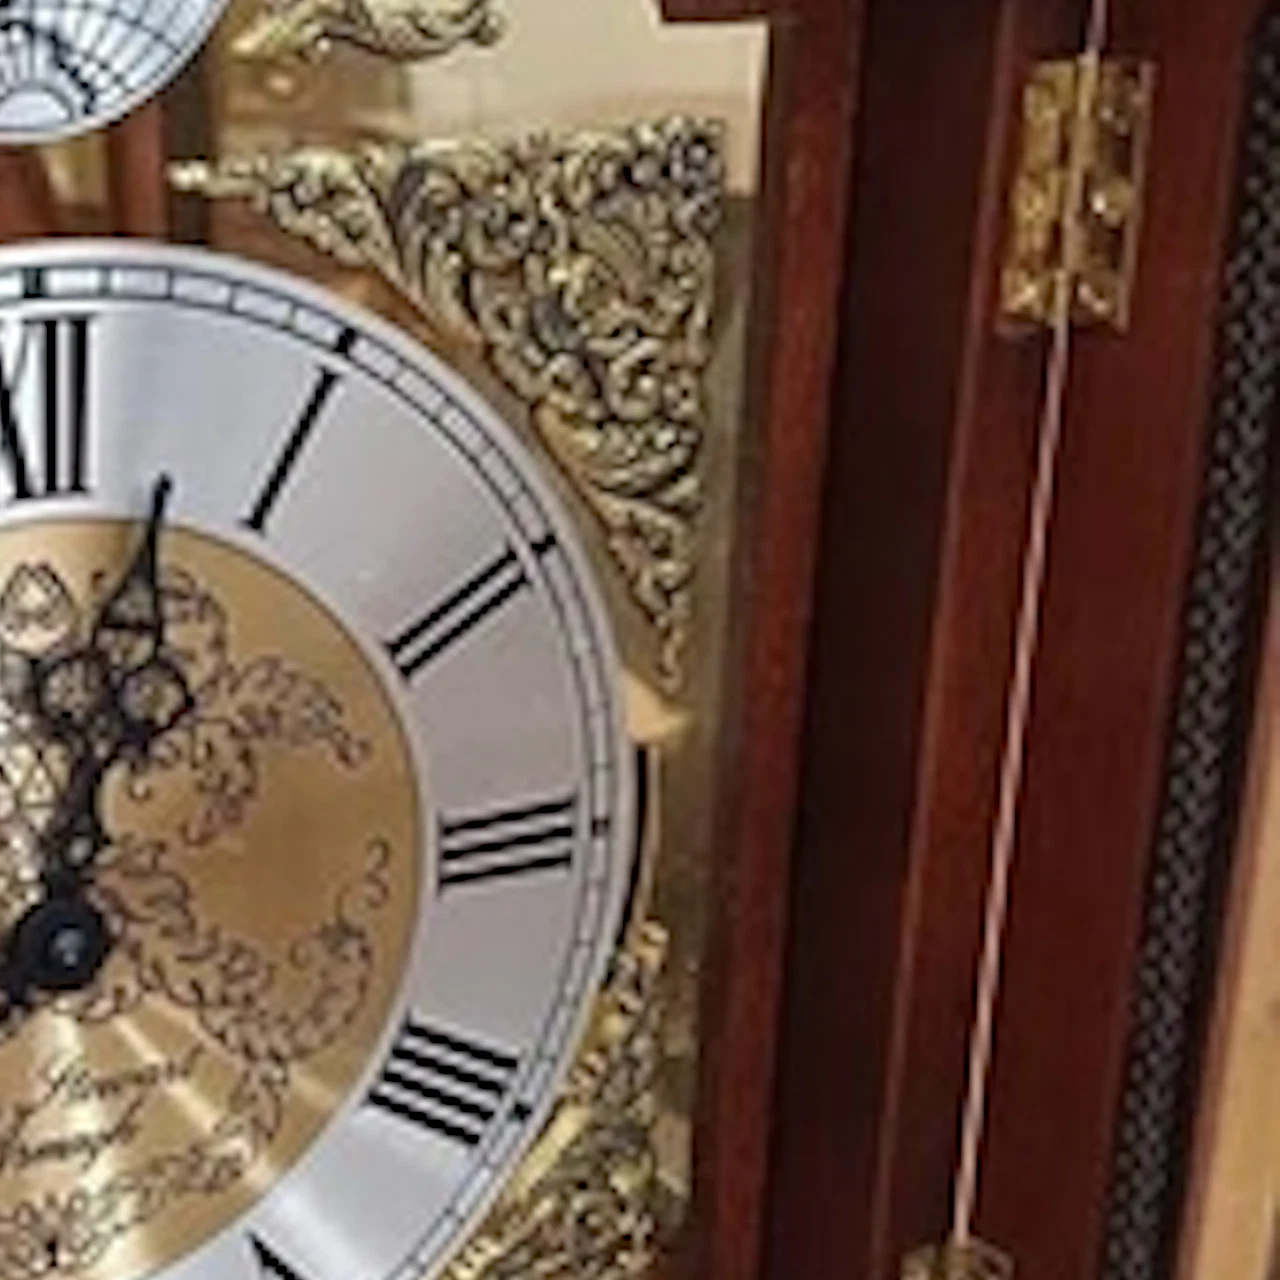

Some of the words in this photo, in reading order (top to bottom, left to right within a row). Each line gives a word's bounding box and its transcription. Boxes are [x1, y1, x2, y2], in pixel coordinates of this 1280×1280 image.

[240, 366, 344, 538] I
[385, 534, 535, 685] II
[438, 794, 578, 898] III
[362, 1008, 527, 1148] IIII
